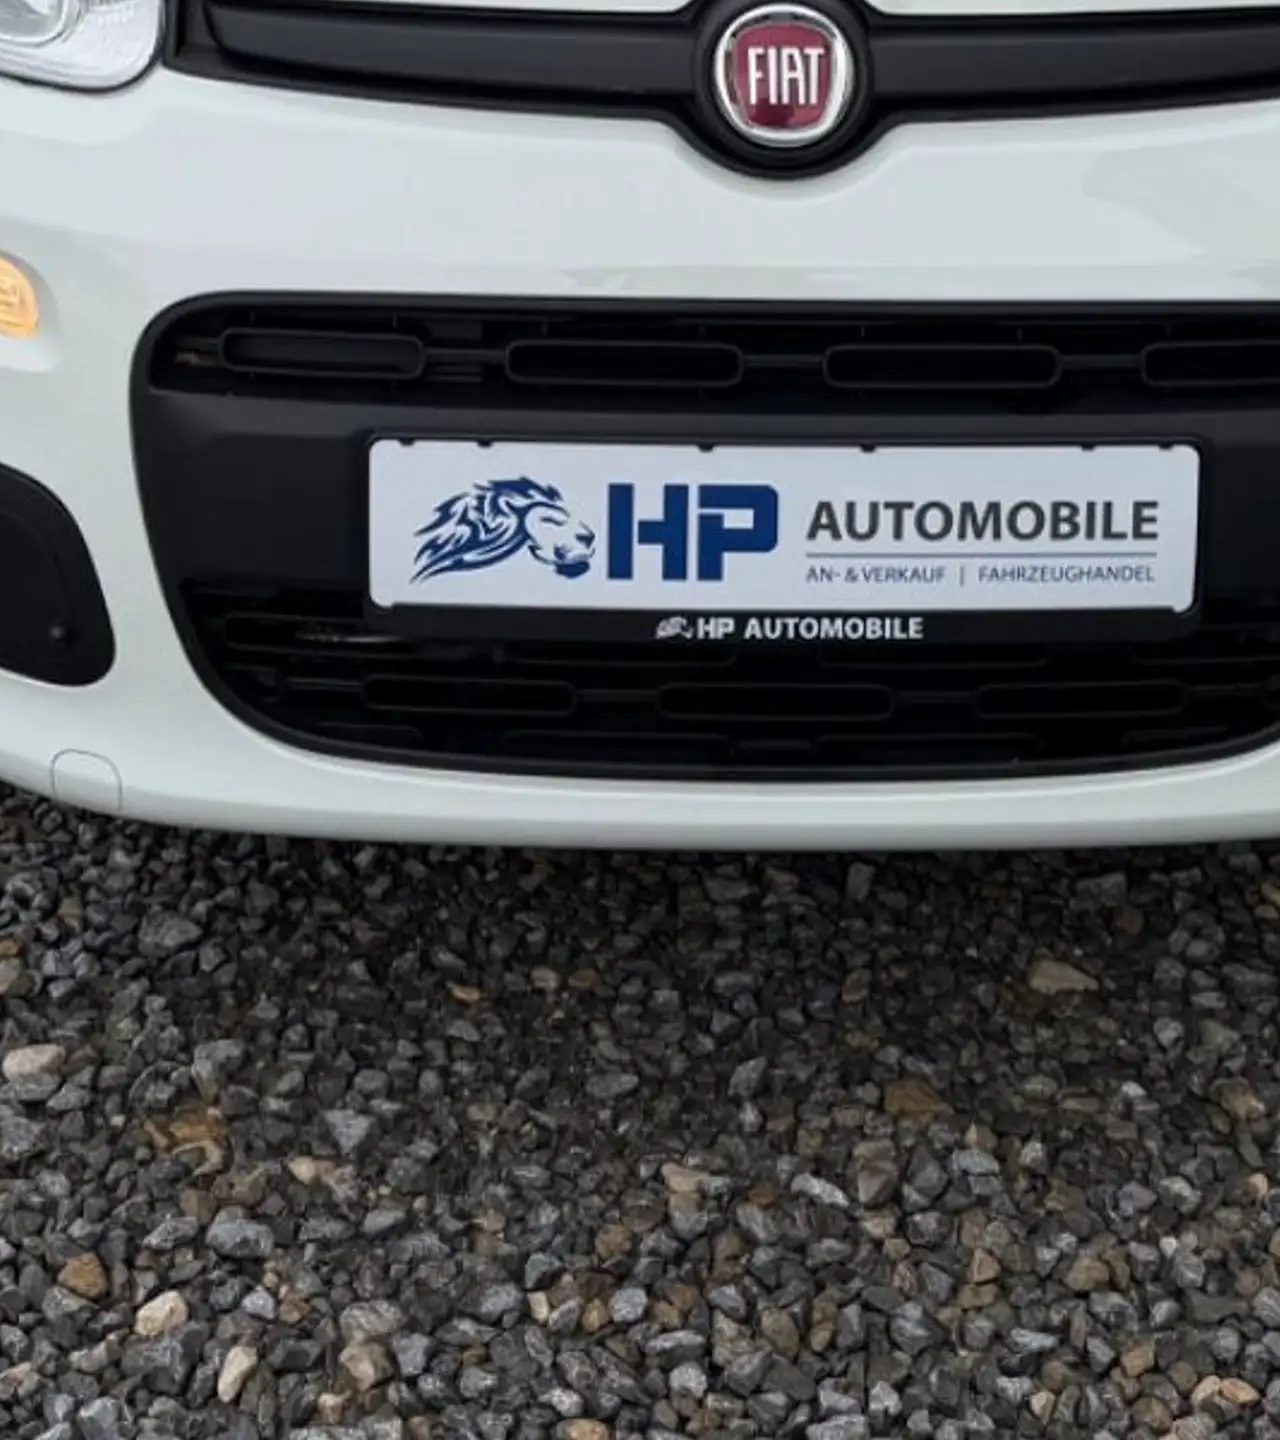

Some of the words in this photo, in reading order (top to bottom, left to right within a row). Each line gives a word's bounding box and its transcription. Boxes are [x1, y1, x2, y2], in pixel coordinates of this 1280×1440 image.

[748, 46, 825, 105] FIAT
[608, 482, 780, 582] HP
[806, 500, 1160, 542] AUTOMOBILE
[978, 565, 1156, 582] FAHRZEUGHANDEL
[697, 616, 735, 639] HP
[743, 616, 924, 639] AUTOMOBILE
